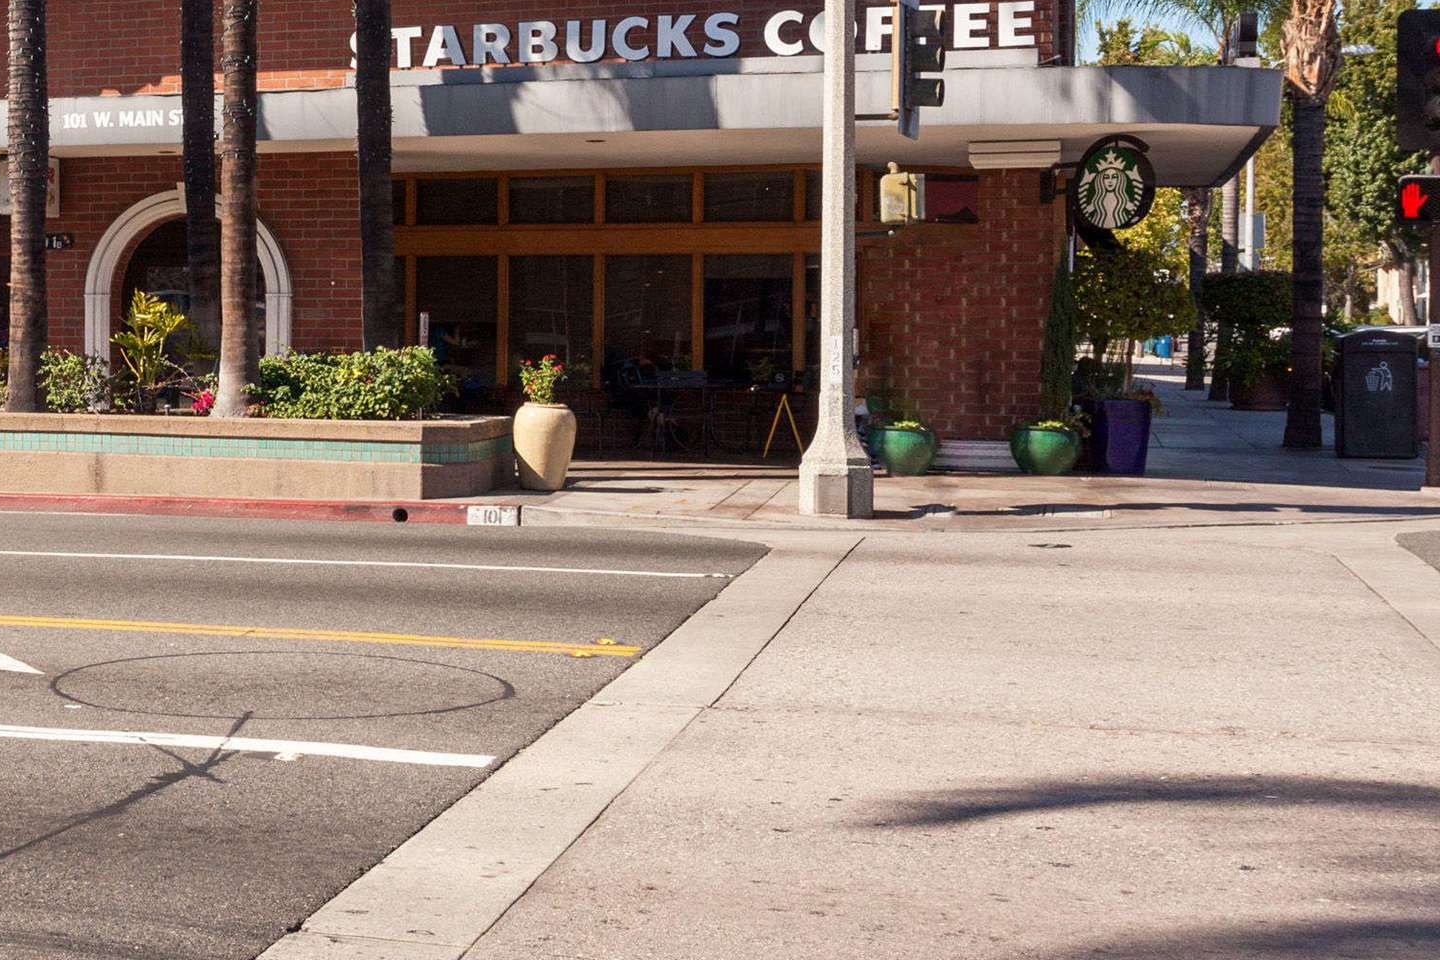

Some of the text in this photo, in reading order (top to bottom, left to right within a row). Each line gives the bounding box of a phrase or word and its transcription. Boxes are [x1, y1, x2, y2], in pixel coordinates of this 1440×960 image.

[63, 113, 88, 129] 101
[93, 111, 114, 128] W.
[119, 110, 164, 127] MAIN
